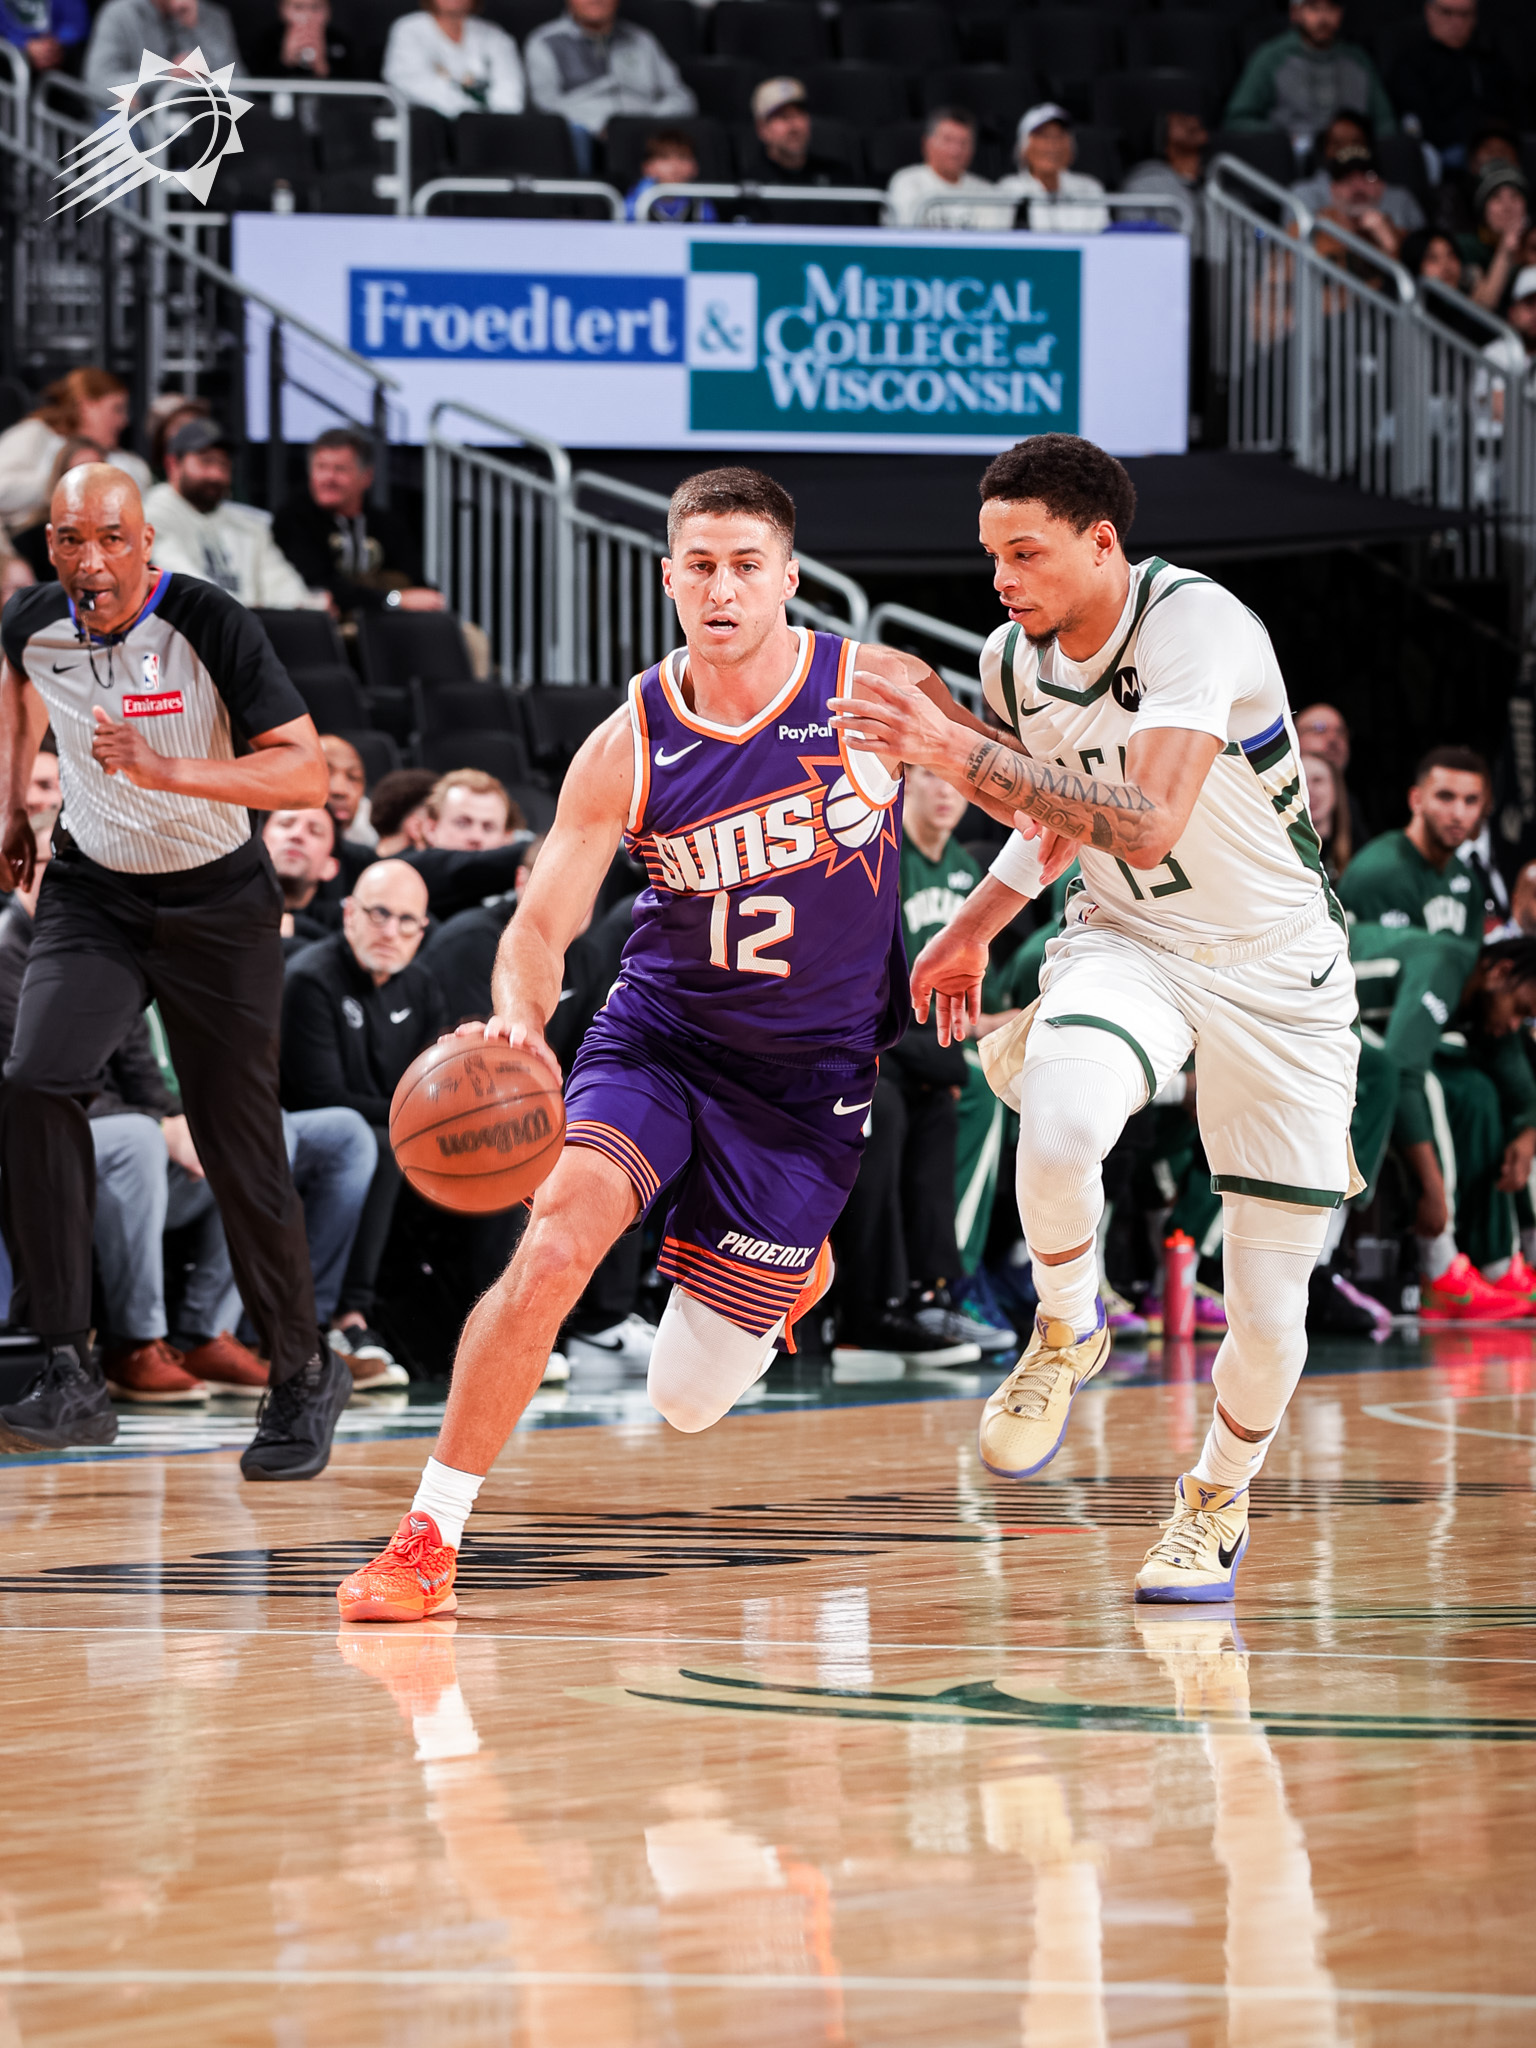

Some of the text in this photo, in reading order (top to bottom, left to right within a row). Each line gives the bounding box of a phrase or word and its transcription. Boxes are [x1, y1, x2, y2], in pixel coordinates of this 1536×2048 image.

[361, 280, 743, 356] Froedtert &
[803, 264, 1048, 323] MEDICAL
[764, 306, 1010, 367] COLLEGE
[764, 350, 1063, 414] WISCONSIN
[124, 696, 183, 714] Emirates
[778, 723, 833, 743] PayPal
[1037, 766, 1156, 811] MMXIX
[651, 794, 816, 892] SUNS
[710, 890, 795, 979] 12
[436, 1104, 552, 1157] Wilson
[717, 1230, 816, 1268] PHOENIX
